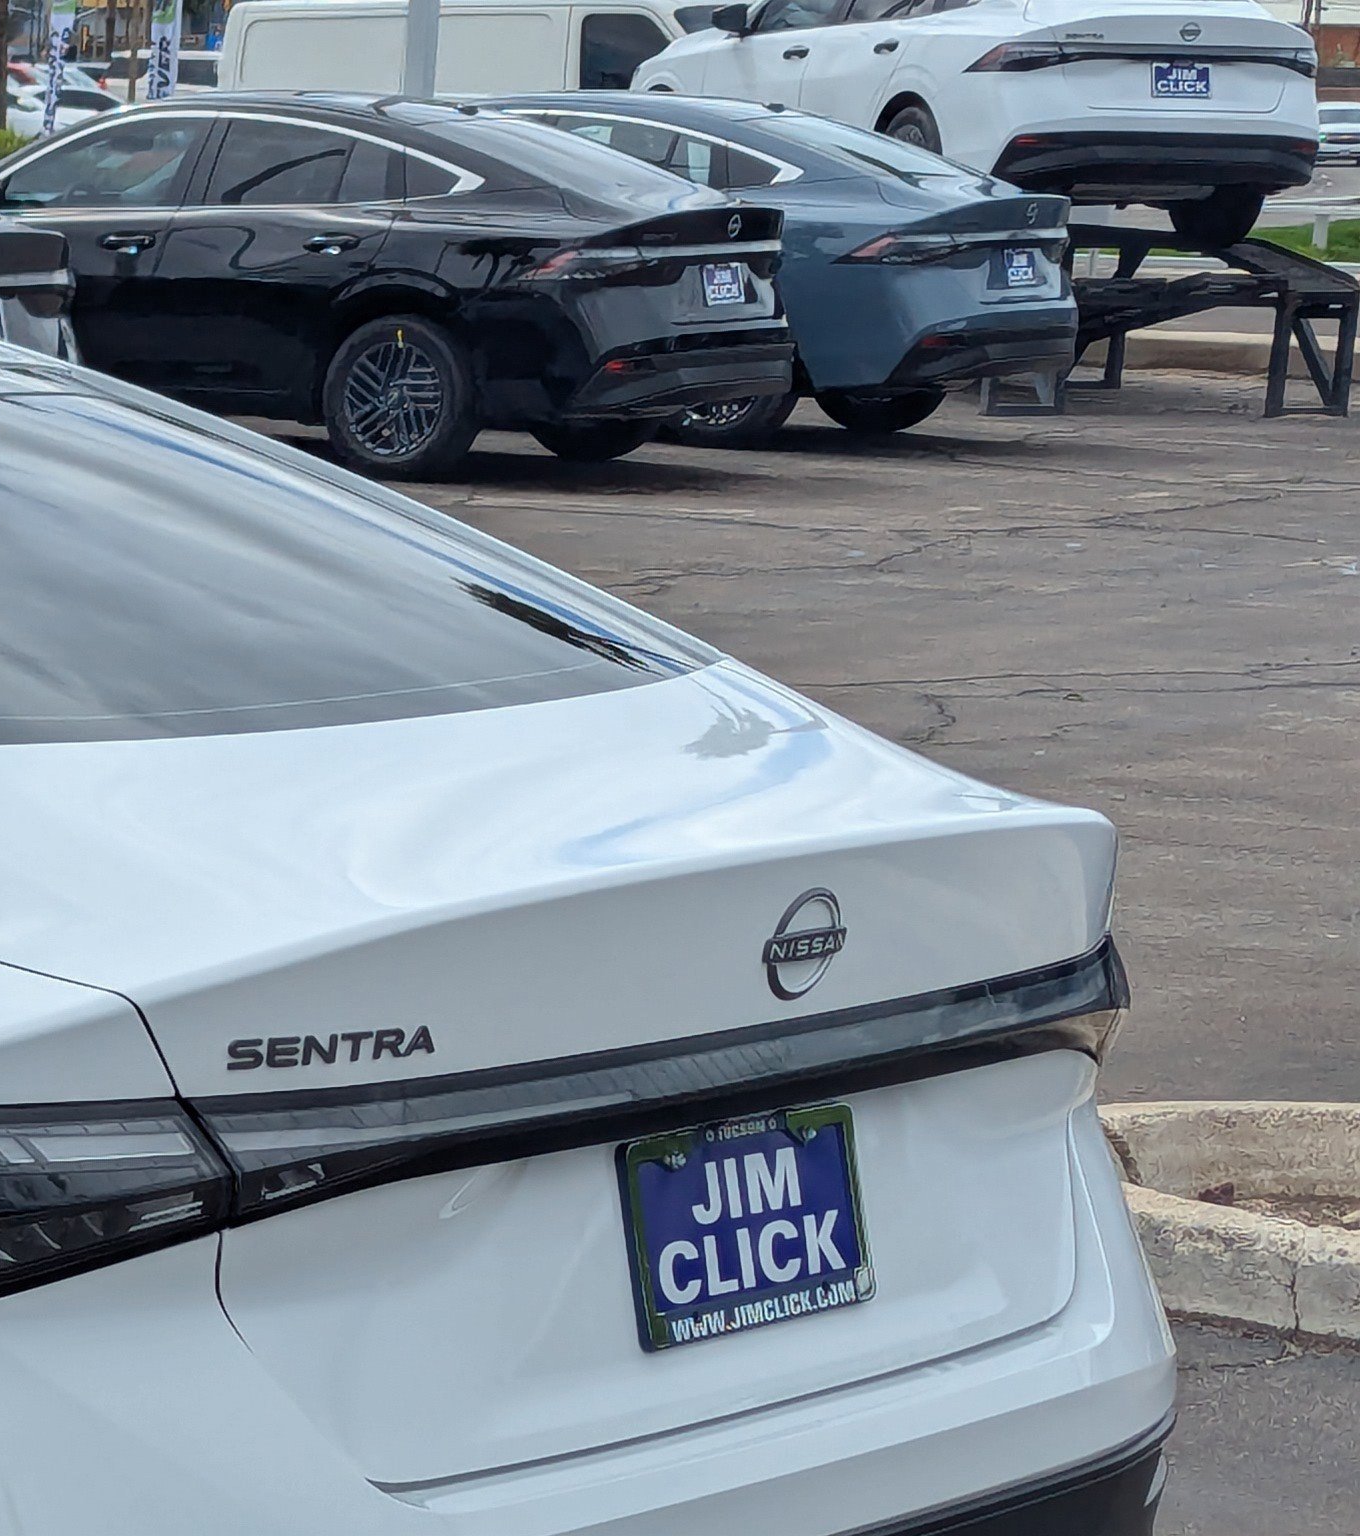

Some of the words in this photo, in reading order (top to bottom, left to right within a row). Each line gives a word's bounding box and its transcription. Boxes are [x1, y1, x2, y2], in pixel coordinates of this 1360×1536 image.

[769, 931, 844, 961] NISSAN
[226, 1025, 436, 1071] SENTRA
[691, 1146, 802, 1226] JIM
[658, 1209, 847, 1305] CLICK
[671, 1279, 856, 1343] WWW.JIMCLICK.COM
